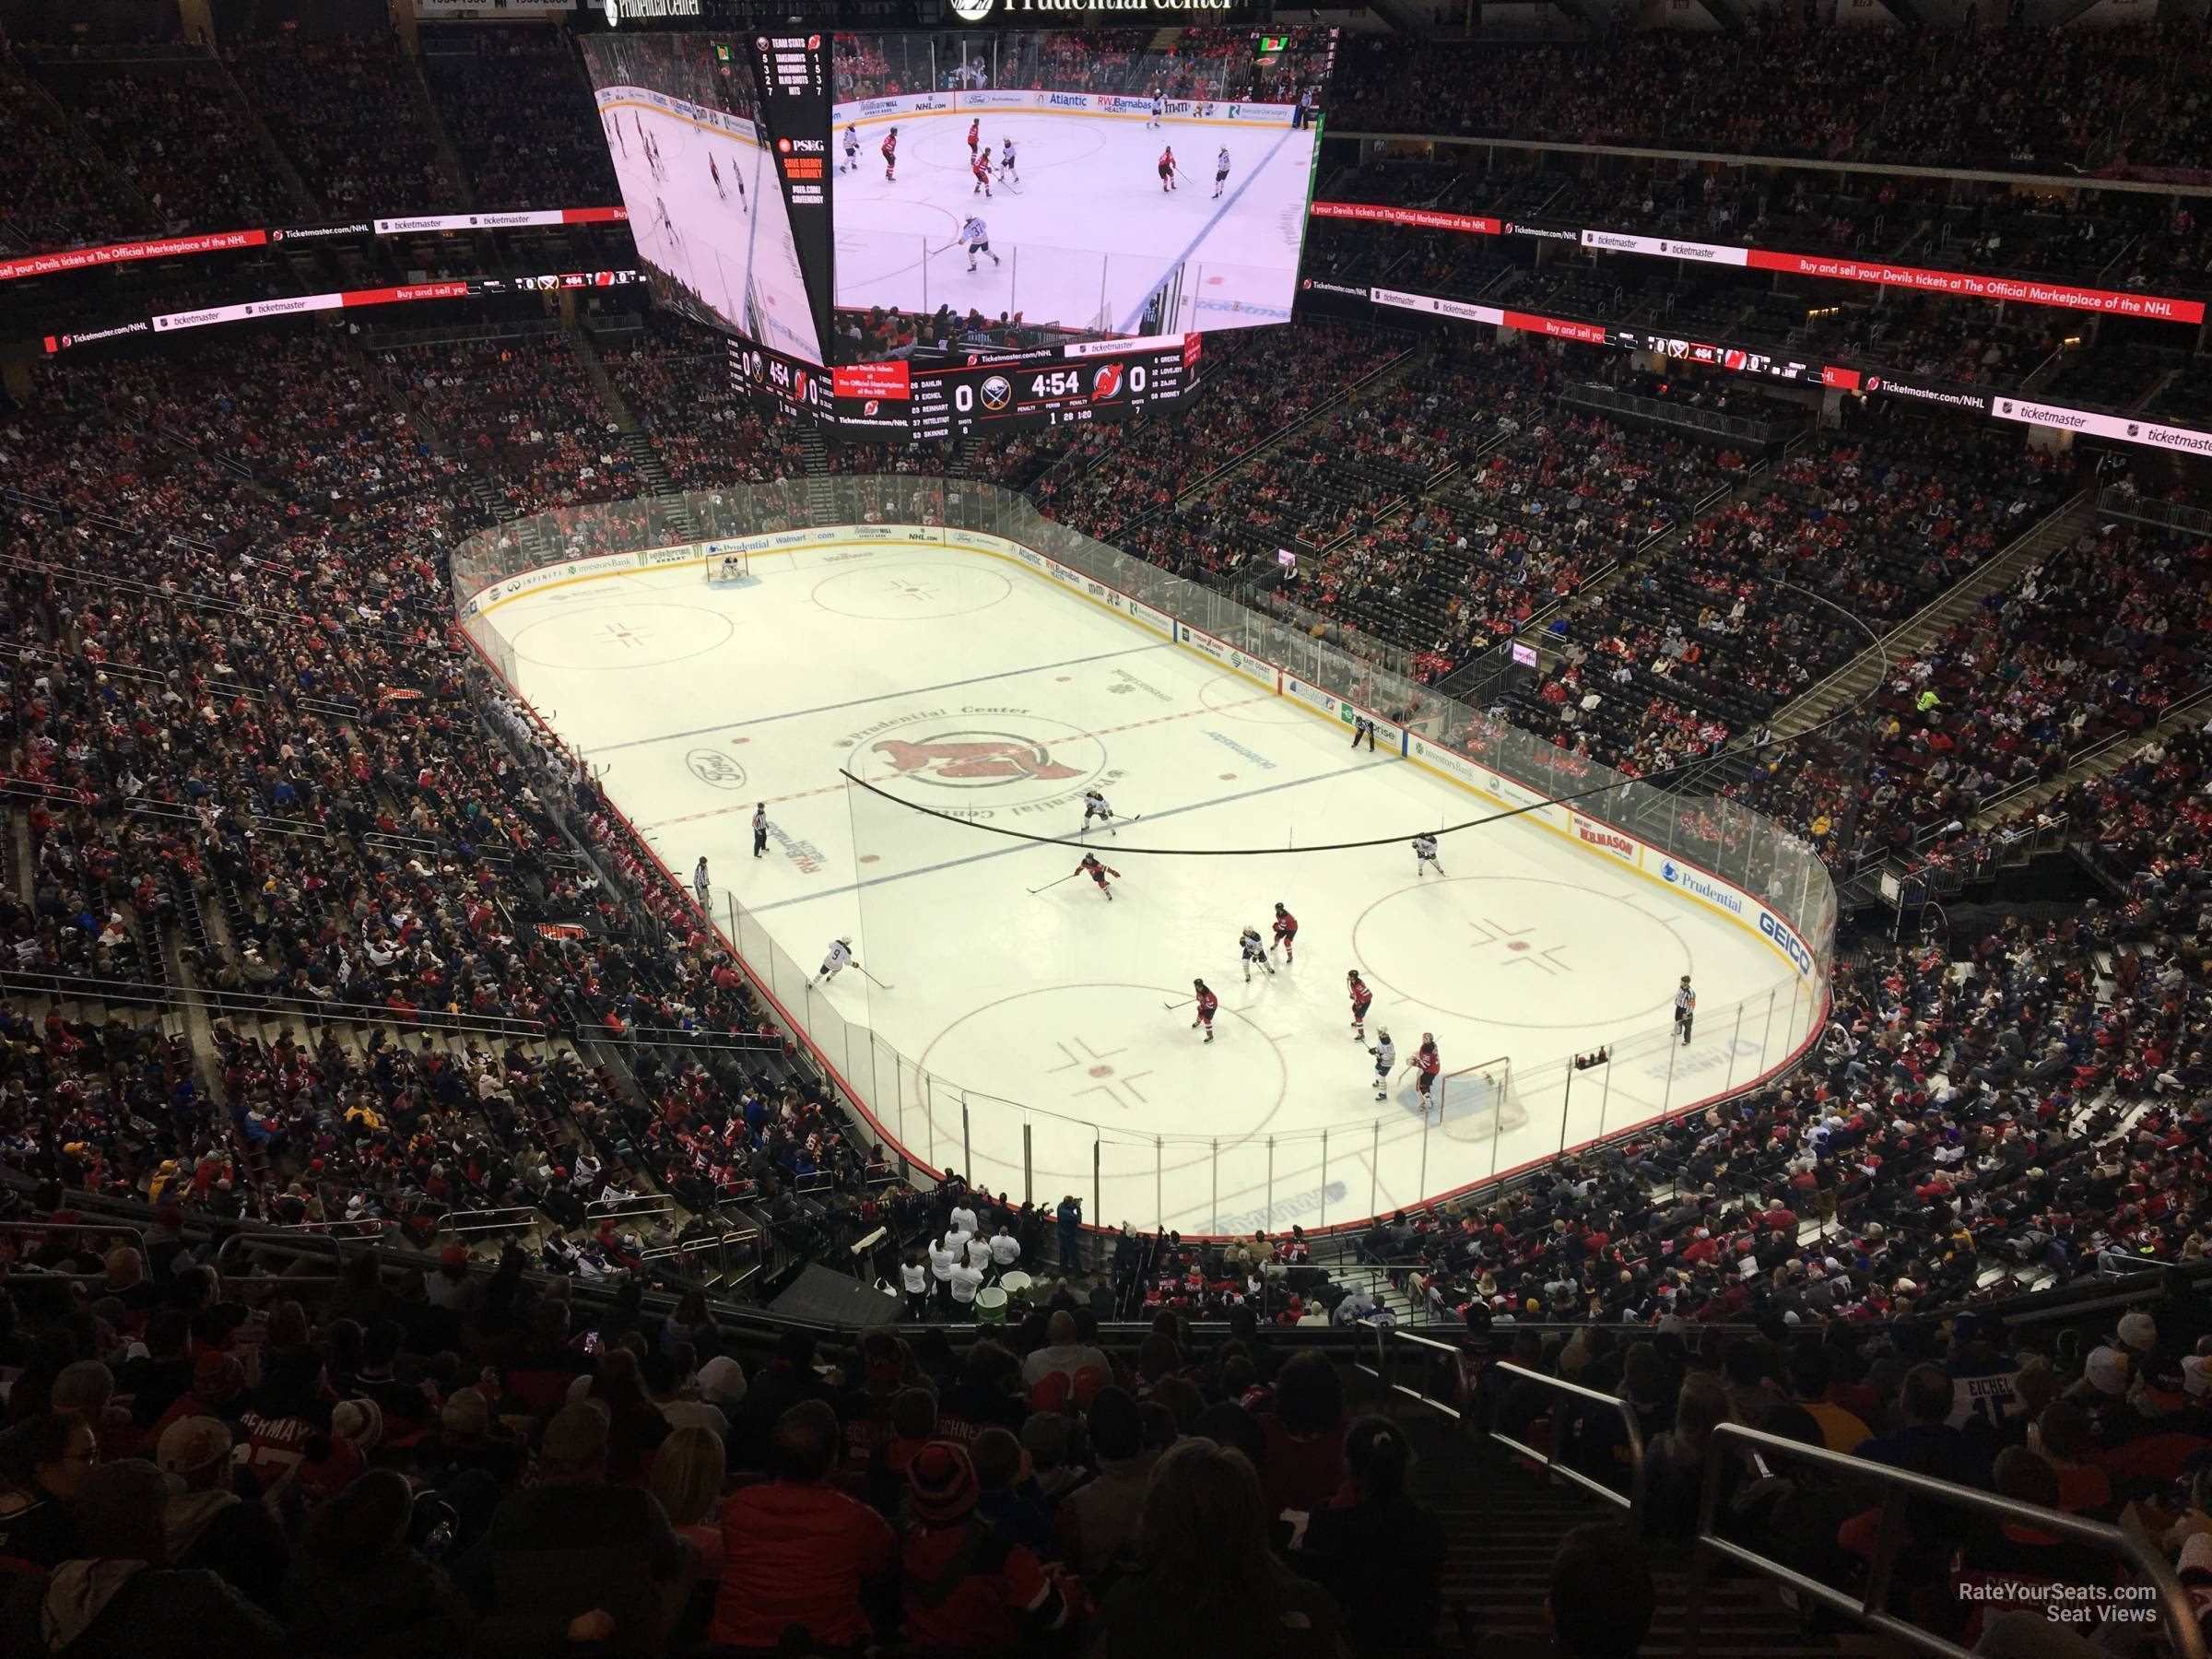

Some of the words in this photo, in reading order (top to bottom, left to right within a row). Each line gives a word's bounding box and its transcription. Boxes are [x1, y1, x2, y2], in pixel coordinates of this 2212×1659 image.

[771, 38, 786, 48] TEAM
[787, 38, 806, 48] STATS
[1049, 93, 1087, 107] Atlantic
[783, 159, 799, 168] SAVE
[800, 159, 823, 168] ENERGY
[483, 215, 532, 226] ticketmaster
[614, 209, 629, 220] Buy
[1315, 205, 1332, 215] your
[1333, 205, 1355, 216] Devils
[1356, 206, 1375, 218] tickets
[1376, 209, 1383, 218] at
[1384, 209, 1395, 219] The
[1395, 210, 1417, 222] Official
[1417, 213, 1453, 228] Marketplace
[1453, 218, 1460, 227] of
[1461, 218, 1471, 229] the
[1472, 220, 1487, 230] NHL
[286, 224, 370, 239] Ticketmaster.com/NHL
[394, 219, 442, 230] ticketmaster
[1514, 224, 1578, 241] Ticketmaster.com/NHL
[1597, 234, 1637, 250] ticketmaster
[15, 264, 34, 277] your
[35, 259, 60, 271] Devils
[61, 256, 86, 267] tickets
[87, 254, 93, 263] at
[96, 251, 111, 261] The
[112, 247, 145, 259] Official
[146, 241, 200, 257] Marketplace
[201, 238, 211, 249] of
[211, 237, 227, 248] the
[228, 235, 247, 246] NHL
[1672, 243, 1716, 260] ticketmaster
[396, 288, 413, 300] Buy
[414, 287, 433, 298] and
[434, 286, 452, 298] sell
[1800, 259, 1818, 275] Buy
[1818, 262, 1838, 275] and
[1840, 264, 1856, 276] sell
[1857, 268, 1881, 283] your
[1883, 268, 1913, 284] Devils
[1915, 272, 1948, 289] tickets
[1950, 276, 1962, 289] at
[1964, 277, 1984, 293] The
[1986, 280, 2028, 299] Official
[2030, 286, 2102, 309] Marketplace
[2104, 295, 2119, 310] of
[2120, 297, 2141, 312] the
[2144, 300, 2172, 317] NHL
[1383, 291, 1416, 306] ticketmaster
[258, 300, 306, 313] ticketmaster
[1442, 303, 1477, 318] ticketmaster
[173, 312, 221, 326] ticketmaster
[73, 323, 148, 345] Ticketmaster.com/NHL
[1546, 322, 1559, 334] Buy
[1561, 324, 1576, 335] and
[1577, 326, 1591, 338] sell
[1091, 342, 1135, 353] ticketmaster
[982, 349, 1053, 364] Ticketmaster.com/NHL
[1160, 355, 1181, 363] GREENE
[1160, 366, 1182, 375] LOVEJOY
[921, 380, 943, 389] DAHLIN
[1031, 371, 1079, 397] 4:54
[1130, 366, 1146, 393] 0
[1160, 379, 1177, 387] ZAJAC
[955, 384, 973, 412] 0
[1882, 380, 1985, 409] Ticketmaster.com/NHL
[922, 404, 948, 413] REINHART
[839, 417, 909, 427] Ticketmaster.com/NHL
[1050, 413, 1056, 425] 1
[2020, 406, 2088, 429] ticketmaster
[924, 429, 948, 439] SKINNER
[775, 533, 806, 545] Walmart
[818, 531, 835, 540] com
[724, 540, 770, 552] Prudential
[1018, 547, 1042, 567] Atlantic
[578, 557, 631, 573] investorsBank
[523, 570, 563, 585] INFINITI
[848, 708, 947, 740] Prudential
[960, 705, 1032, 715] Center
[1425, 748, 1475, 780] investorsBank
[1682, 872, 1743, 914] Prudential
[1759, 911, 1812, 976] GEICO
[831, 948, 841, 960] 9
[1969, 1377, 2014, 1397] EICHEL
